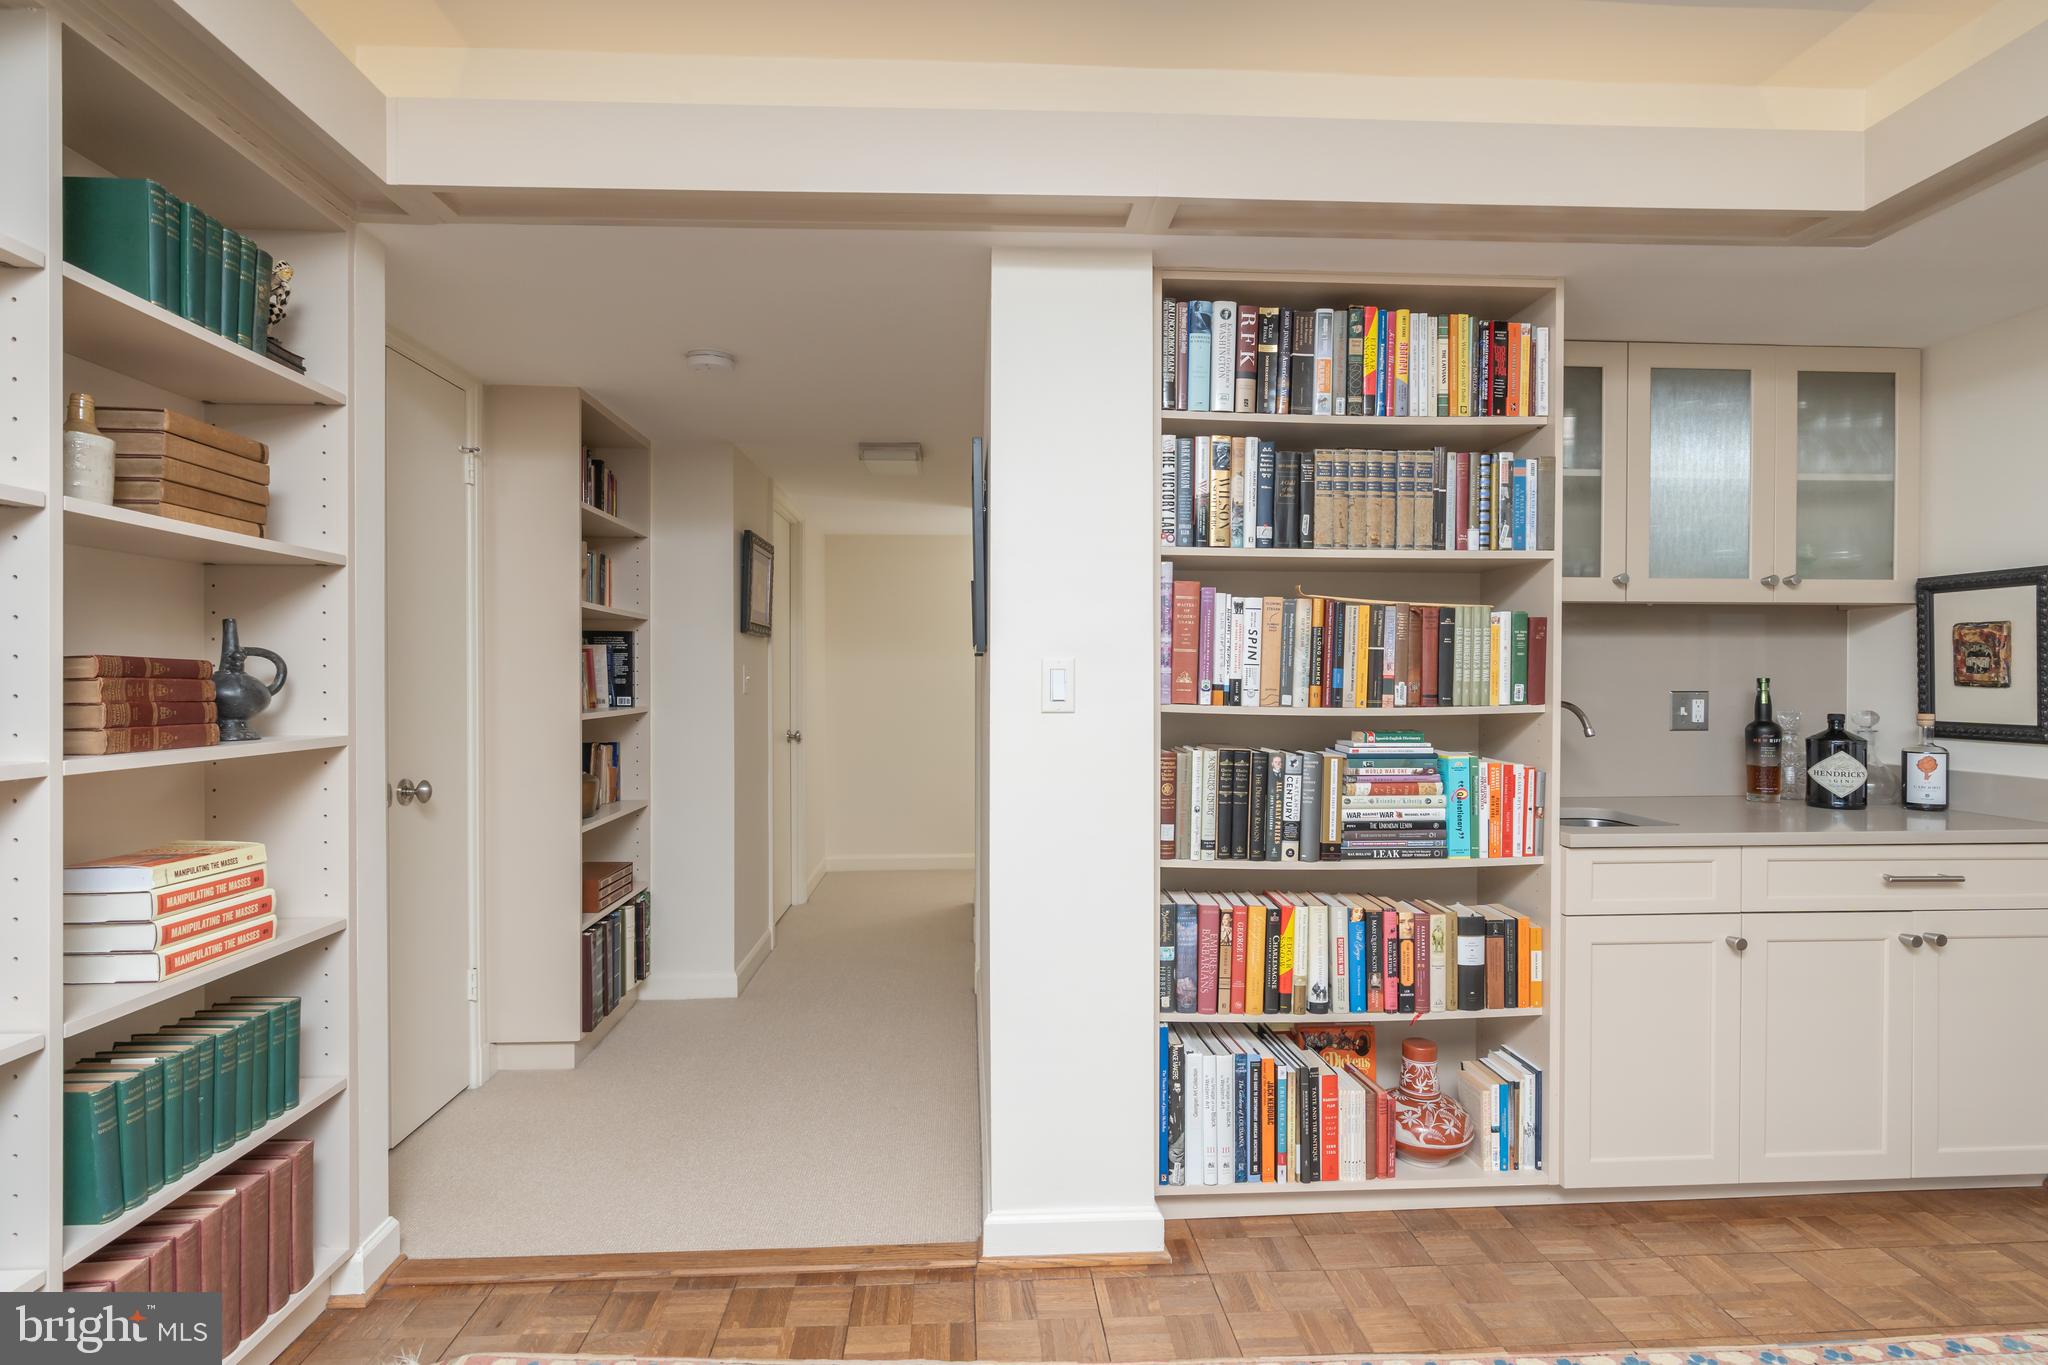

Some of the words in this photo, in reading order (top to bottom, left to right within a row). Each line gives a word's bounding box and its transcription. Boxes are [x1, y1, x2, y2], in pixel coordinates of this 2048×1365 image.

[1168, 302, 1175, 312] AN
[1218, 322, 1226, 378] WASHINGTON
[1162, 451, 1175, 468] THE
[1181, 440, 1191, 457] DARK
[1181, 459, 1190, 489] INVASION
[1162, 472, 1174, 512] VICTORY
[1219, 477, 1230, 529] WILSON
[1162, 517, 1174, 534] LAB
[1248, 629, 1258, 661] SPIN
[1285, 776, 1293, 820] CENTURY
[174, 863, 210, 878] MANIPULATING
[210, 861, 220, 870] THE
[221, 857, 239, 868] MASSES
[1374, 850, 1399, 858] LEAK
[166, 886, 214, 908] MANIPULATING
[216, 883, 227, 896] THE
[228, 877, 251, 892] MASSES
[171, 913, 221, 938] MANIPULATING
[222, 910, 234, 923] THE
[235, 903, 259, 920] MASSES
[174, 940, 223, 968] MANIPULATING
[224, 936, 235, 949] THE
[237, 929, 260, 945] MASSES
[1236, 922, 1244, 953] GEORGE
[1200, 928, 1210, 994] BARBARIANS
[1209, 933, 1218, 975] EMPIRES
[1236, 954, 1243, 963] IV
[1271, 935, 1280, 990] CHARLEMAGNE
